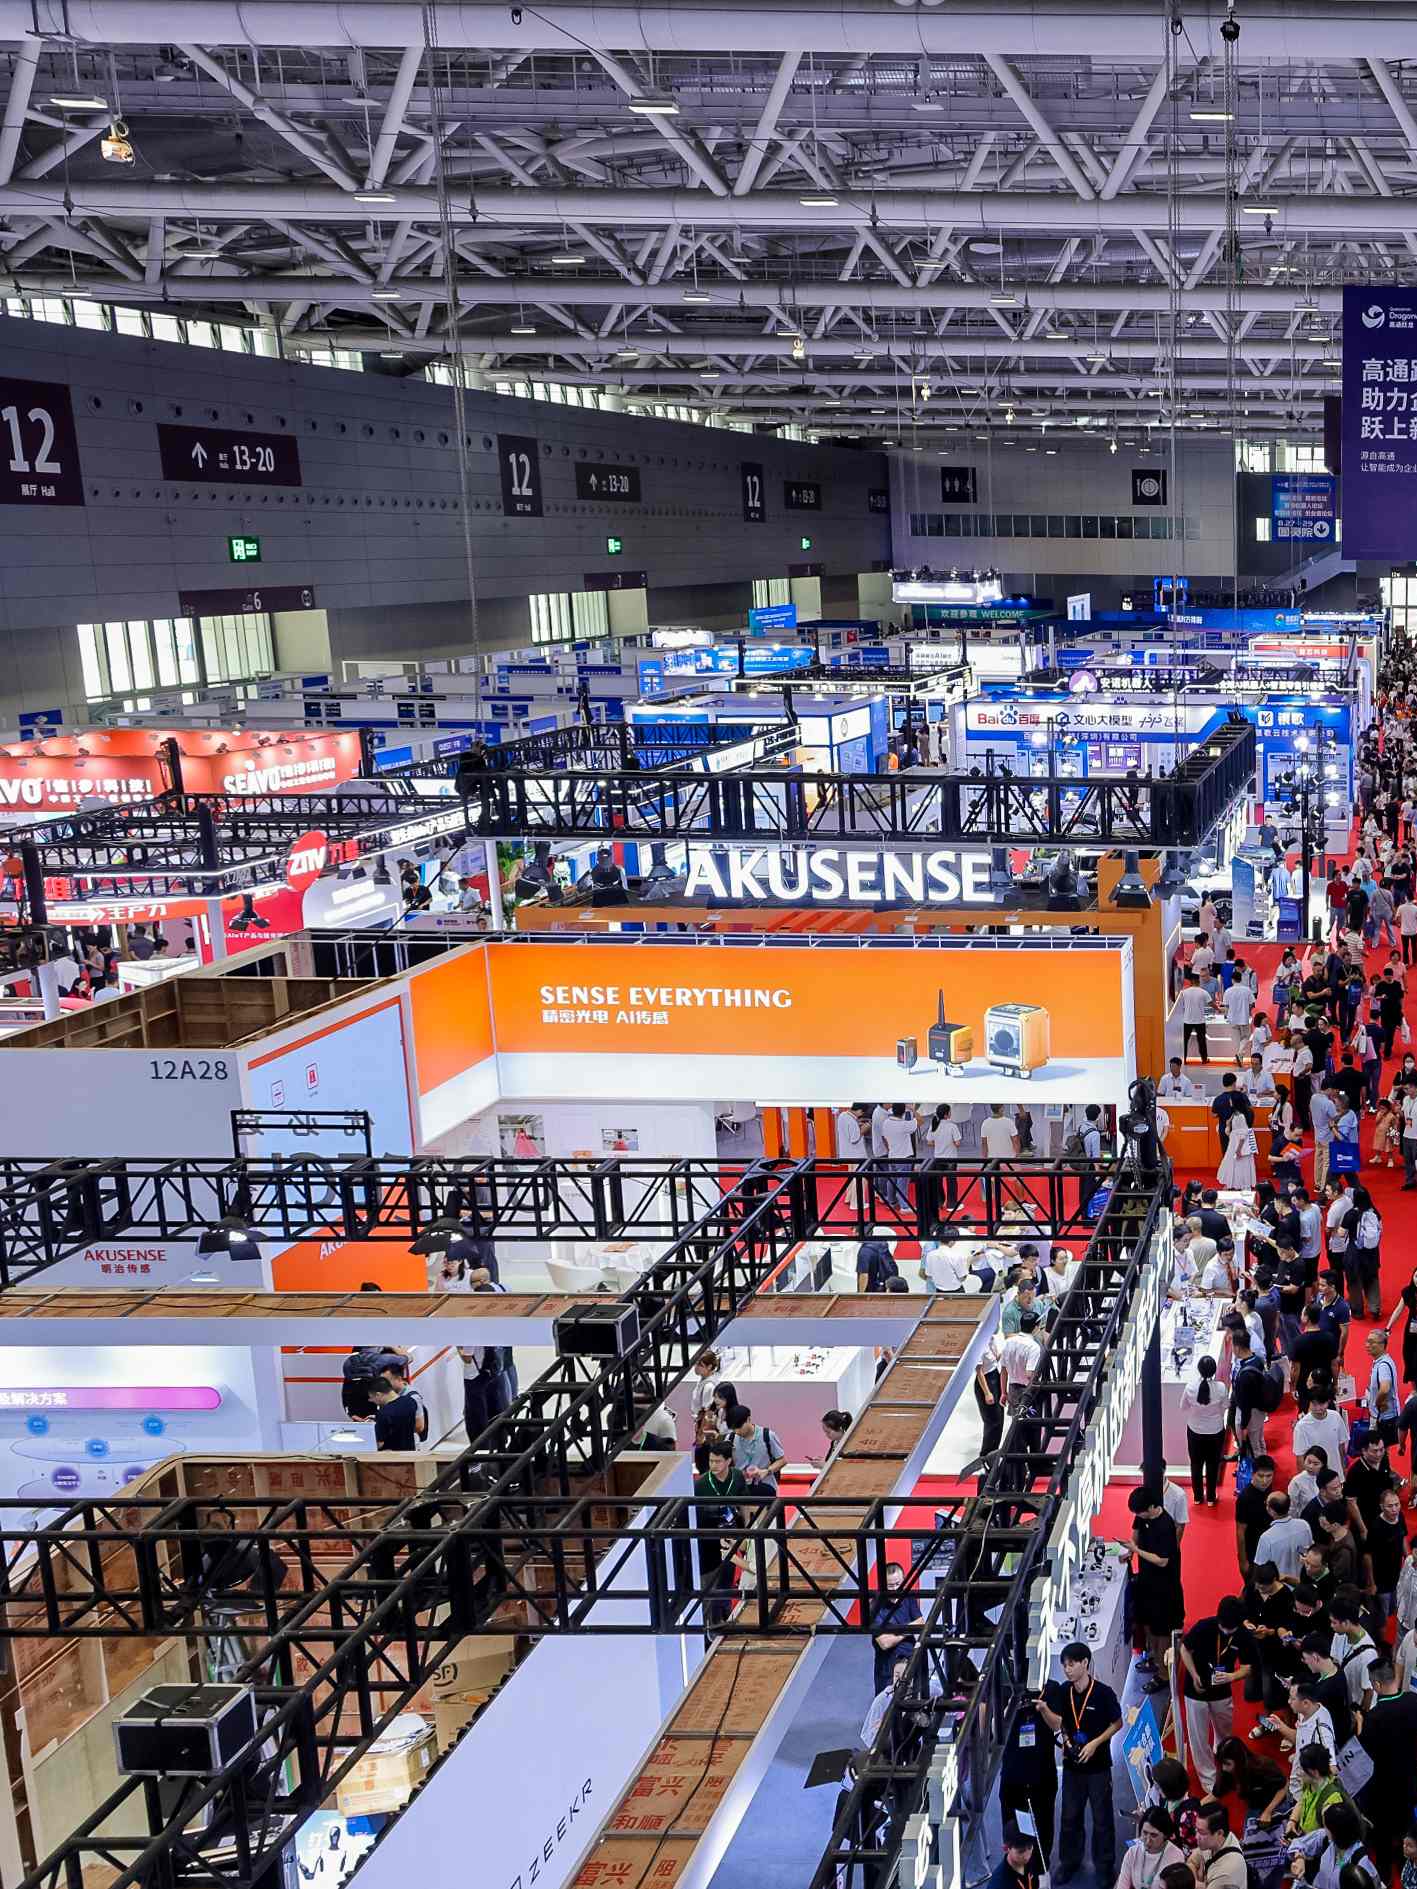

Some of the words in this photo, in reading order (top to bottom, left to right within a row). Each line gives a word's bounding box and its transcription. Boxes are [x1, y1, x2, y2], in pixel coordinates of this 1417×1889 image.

[1, 406, 61, 474] 12
[233, 445, 275, 472] 13-20
[509, 453, 533, 496] 12
[746, 475, 761, 507] 12
[253, 592, 262, 609] 6
[980, 609, 1025, 619] WELCOME
[977, 710, 1017, 725] Baidu
[1073, 713, 1133, 727] 文心大模型
[0, 777, 43, 805] VO
[683, 848, 996, 902] AKUSENSE
[540, 985, 621, 1006] SENSE
[629, 986, 793, 1008] EVERYTHING
[541, 1009, 610, 1025] 精密光电
[616, 1010, 670, 1025] AI传感
[151, 1060, 229, 1081] 12A28
[84, 1248, 168, 1262] AKUSENSE
[101, 1263, 152, 1275] 明治传感
[528, 1777, 593, 1886] ZEEKR
